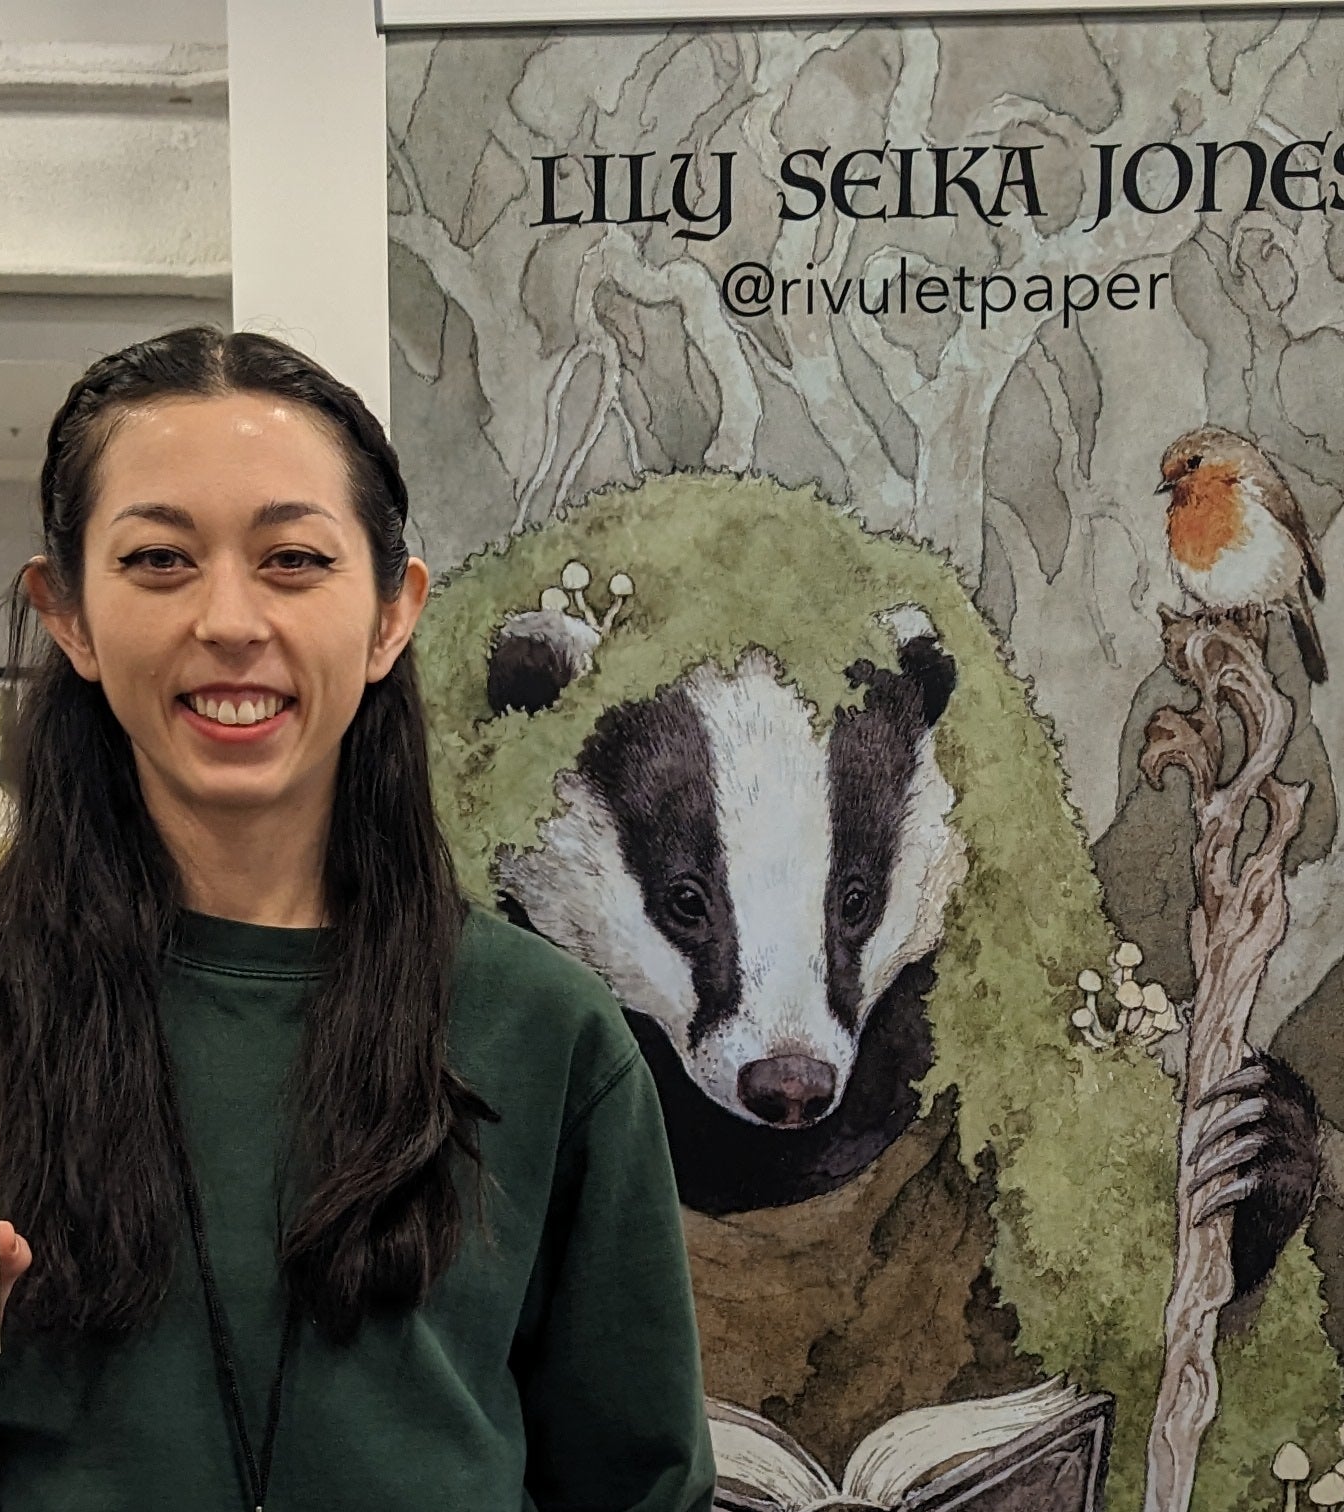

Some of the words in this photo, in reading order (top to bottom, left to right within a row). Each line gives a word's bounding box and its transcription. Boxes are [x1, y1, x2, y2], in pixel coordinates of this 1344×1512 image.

[529, 151, 737, 242] LILY
[776, 139, 1049, 228] SEIKA
[721, 256, 1171, 330] @rivuletpaper
